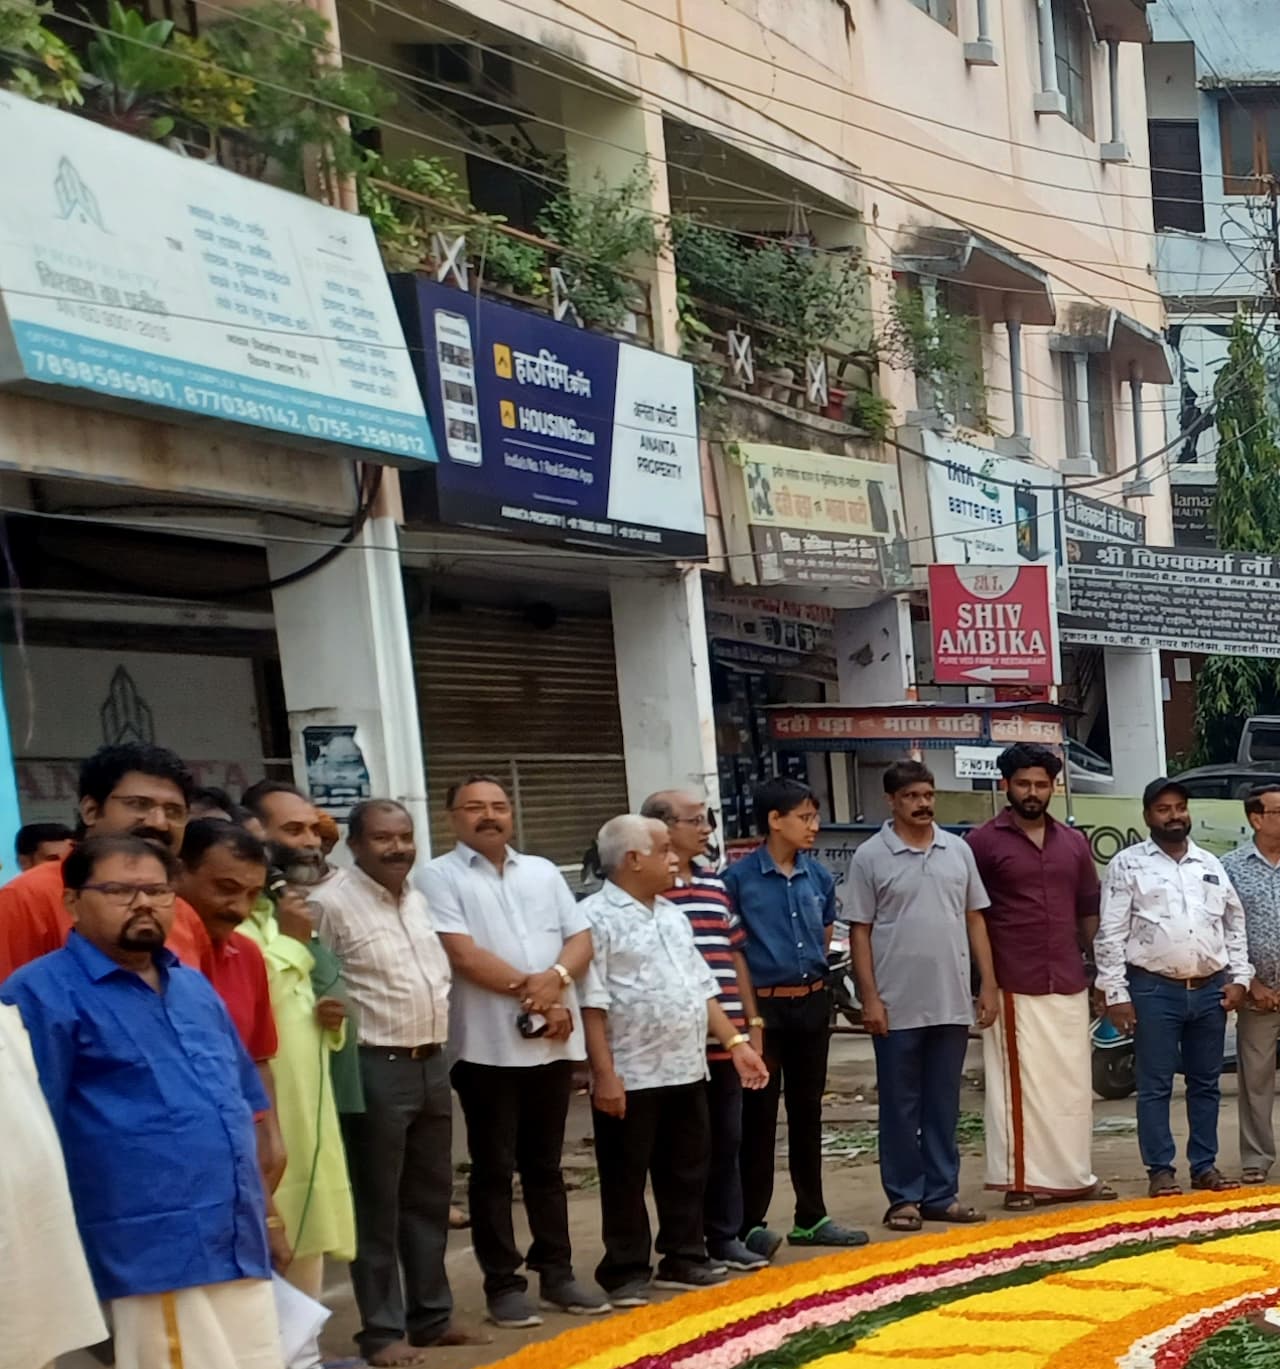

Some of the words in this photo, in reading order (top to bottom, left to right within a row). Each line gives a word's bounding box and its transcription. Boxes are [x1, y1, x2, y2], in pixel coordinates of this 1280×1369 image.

[1096, 545, 1127, 566] श्री
[1131, 548, 1235, 574] विश्वकर्मा
[1239, 554, 1274, 576] लॉ
[957, 602, 1023, 629] SHIV
[937, 629, 1047, 656] AMBIKA
[970, 760, 983, 770] NO
